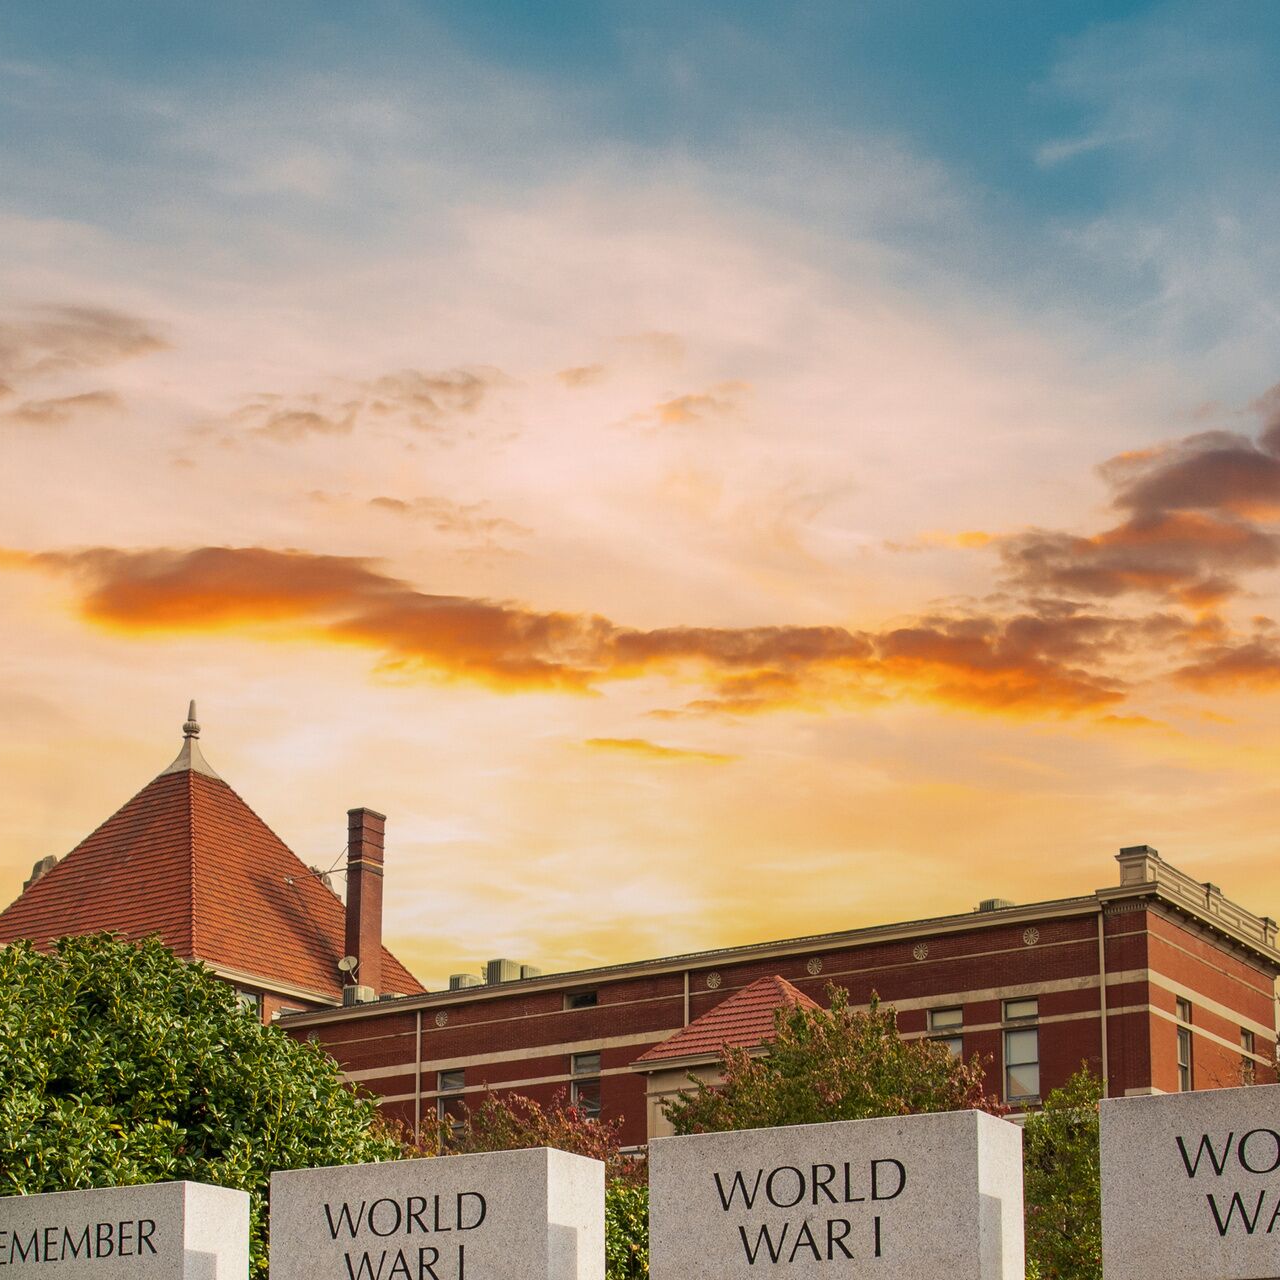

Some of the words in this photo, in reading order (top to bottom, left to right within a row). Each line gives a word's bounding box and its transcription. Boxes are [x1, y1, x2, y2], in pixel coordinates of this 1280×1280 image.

[713, 1158, 907, 1212] WORLD
[324, 1191, 488, 1241] WORLD
[738, 1218, 855, 1266] WAR
[873, 1216, 882, 1258] I
